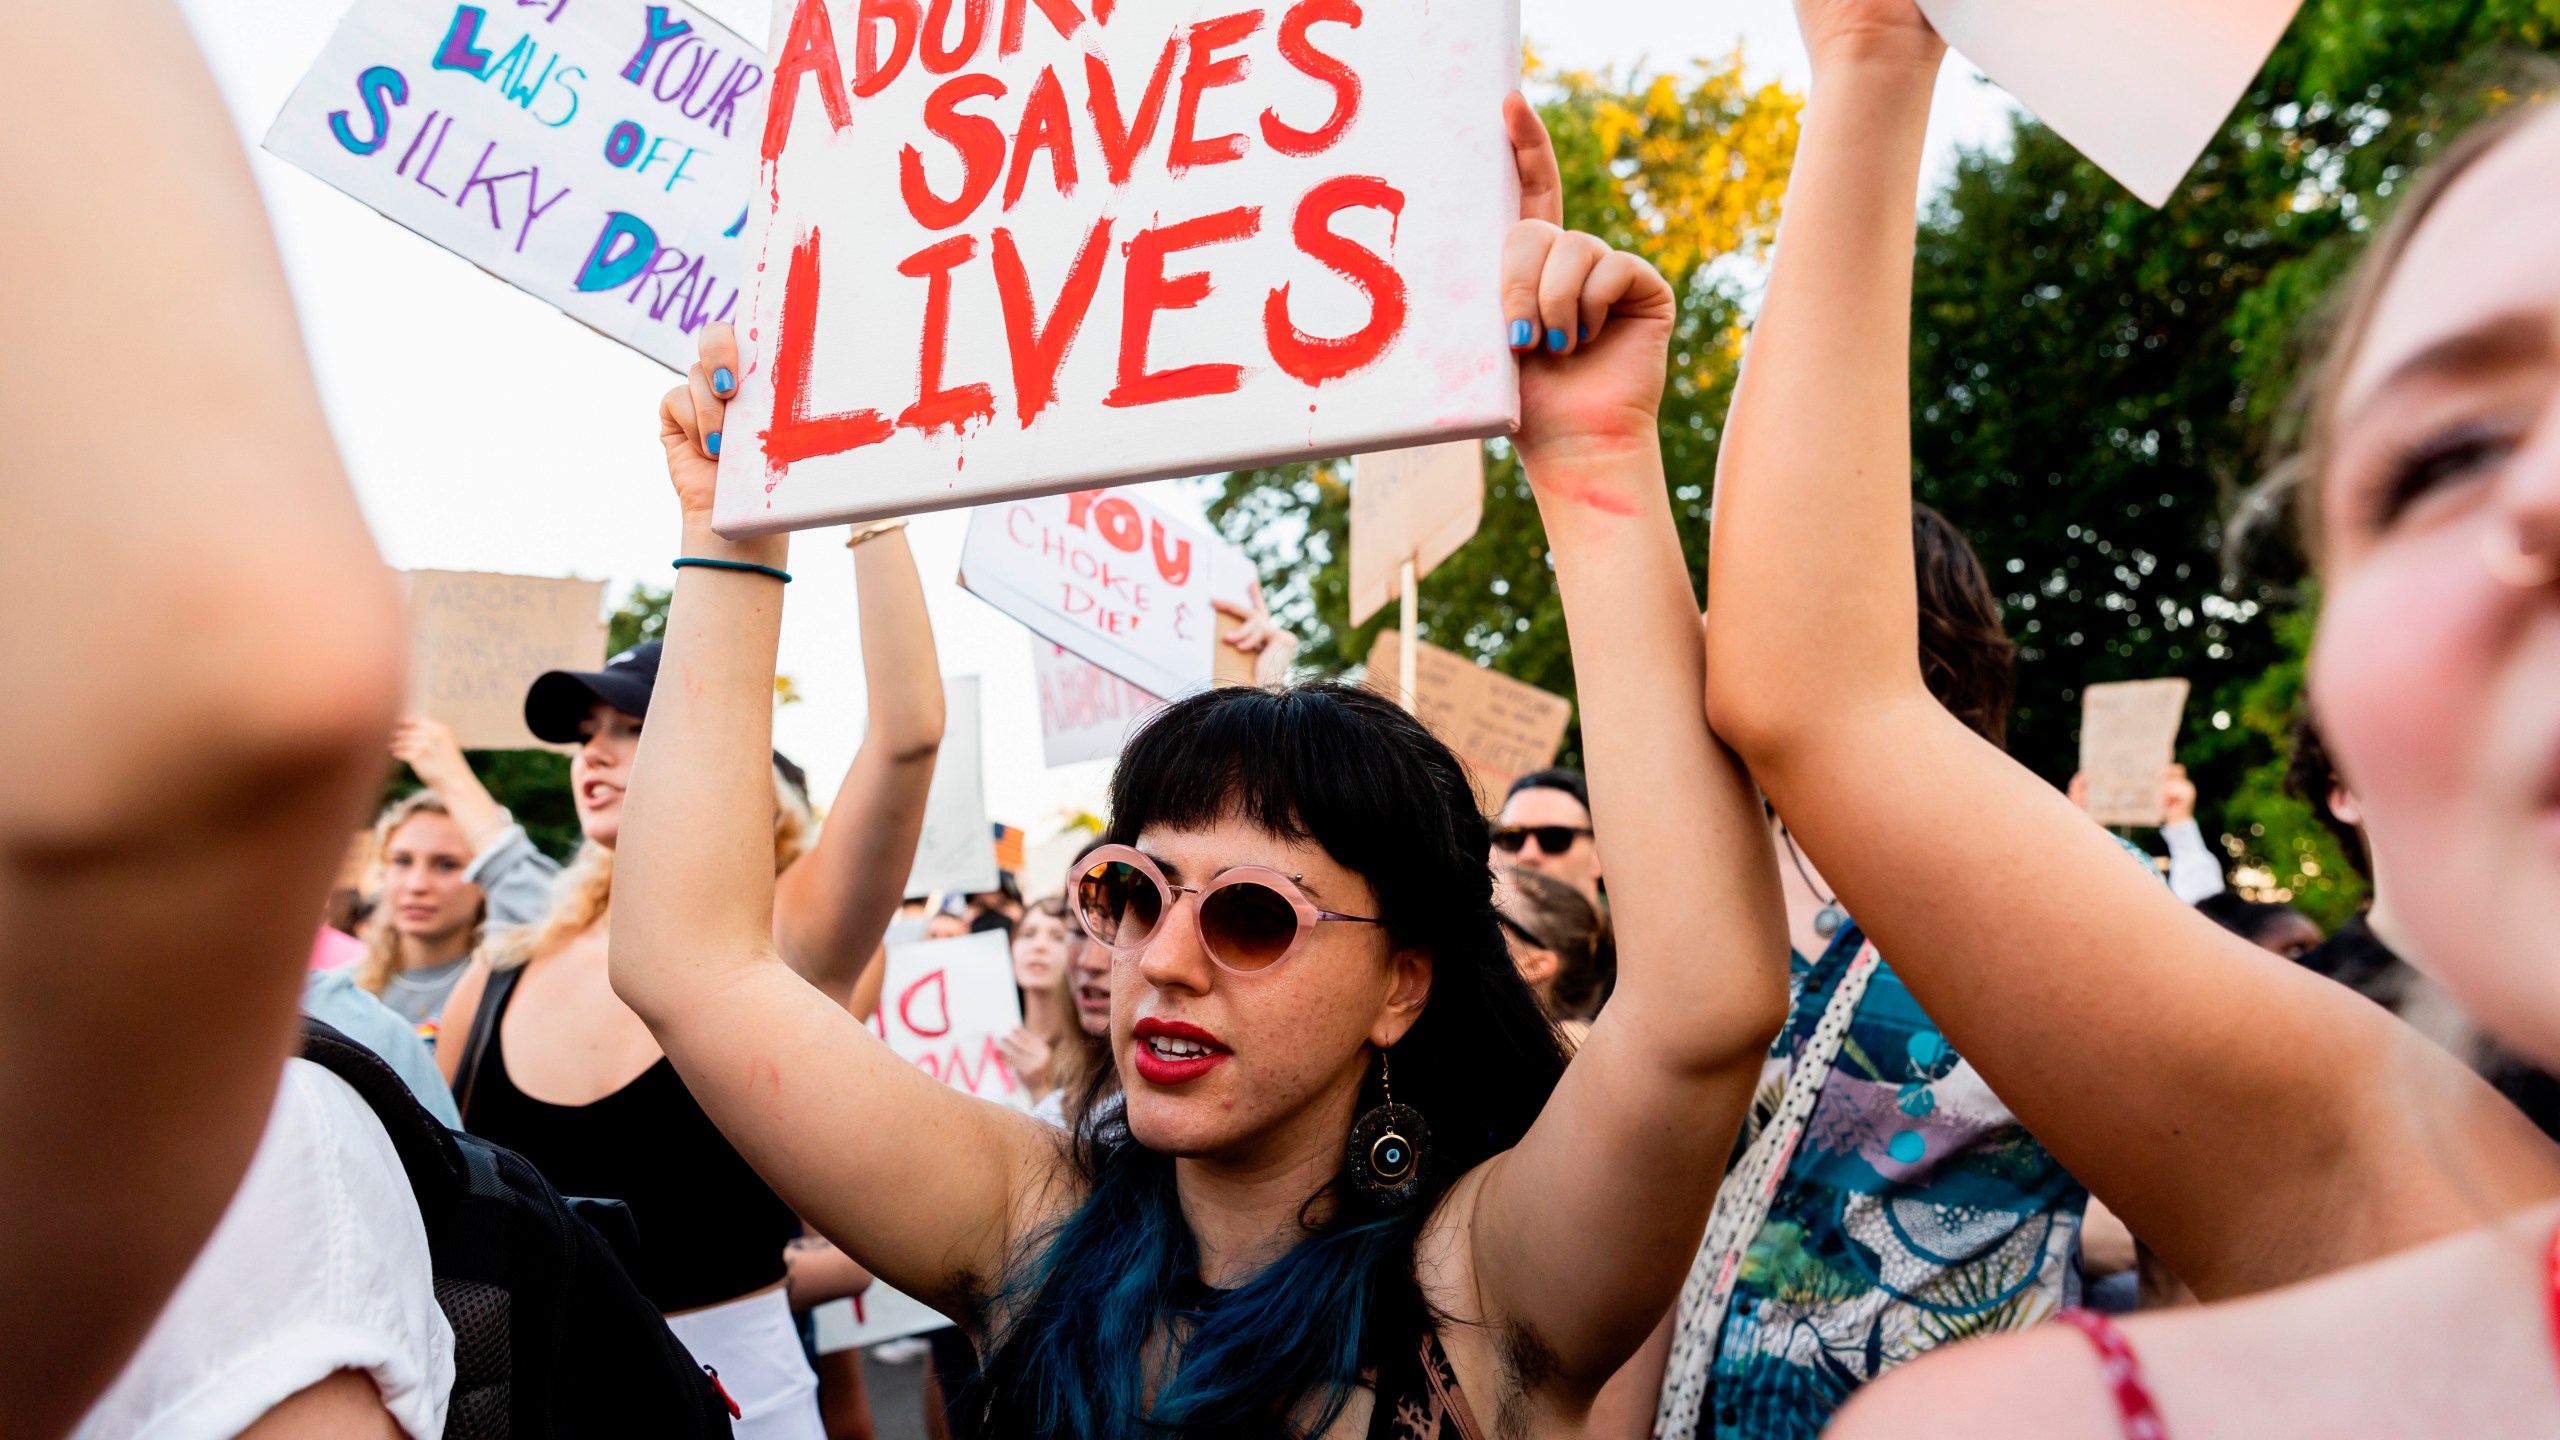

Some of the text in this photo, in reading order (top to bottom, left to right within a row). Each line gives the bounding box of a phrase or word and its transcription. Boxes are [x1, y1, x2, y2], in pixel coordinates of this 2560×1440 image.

[433, 5, 714, 193] LAWS OFF
[619, 5, 763, 138] YOUR
[898, 0, 1364, 231] SAVES
[328, 65, 741, 335] SILKY DRAW
[757, 173, 1409, 468] LIVES
[430, 581, 562, 613] ABORT
[1007, 504, 1151, 612] CHOKE
[1066, 487, 1191, 587] YOU
